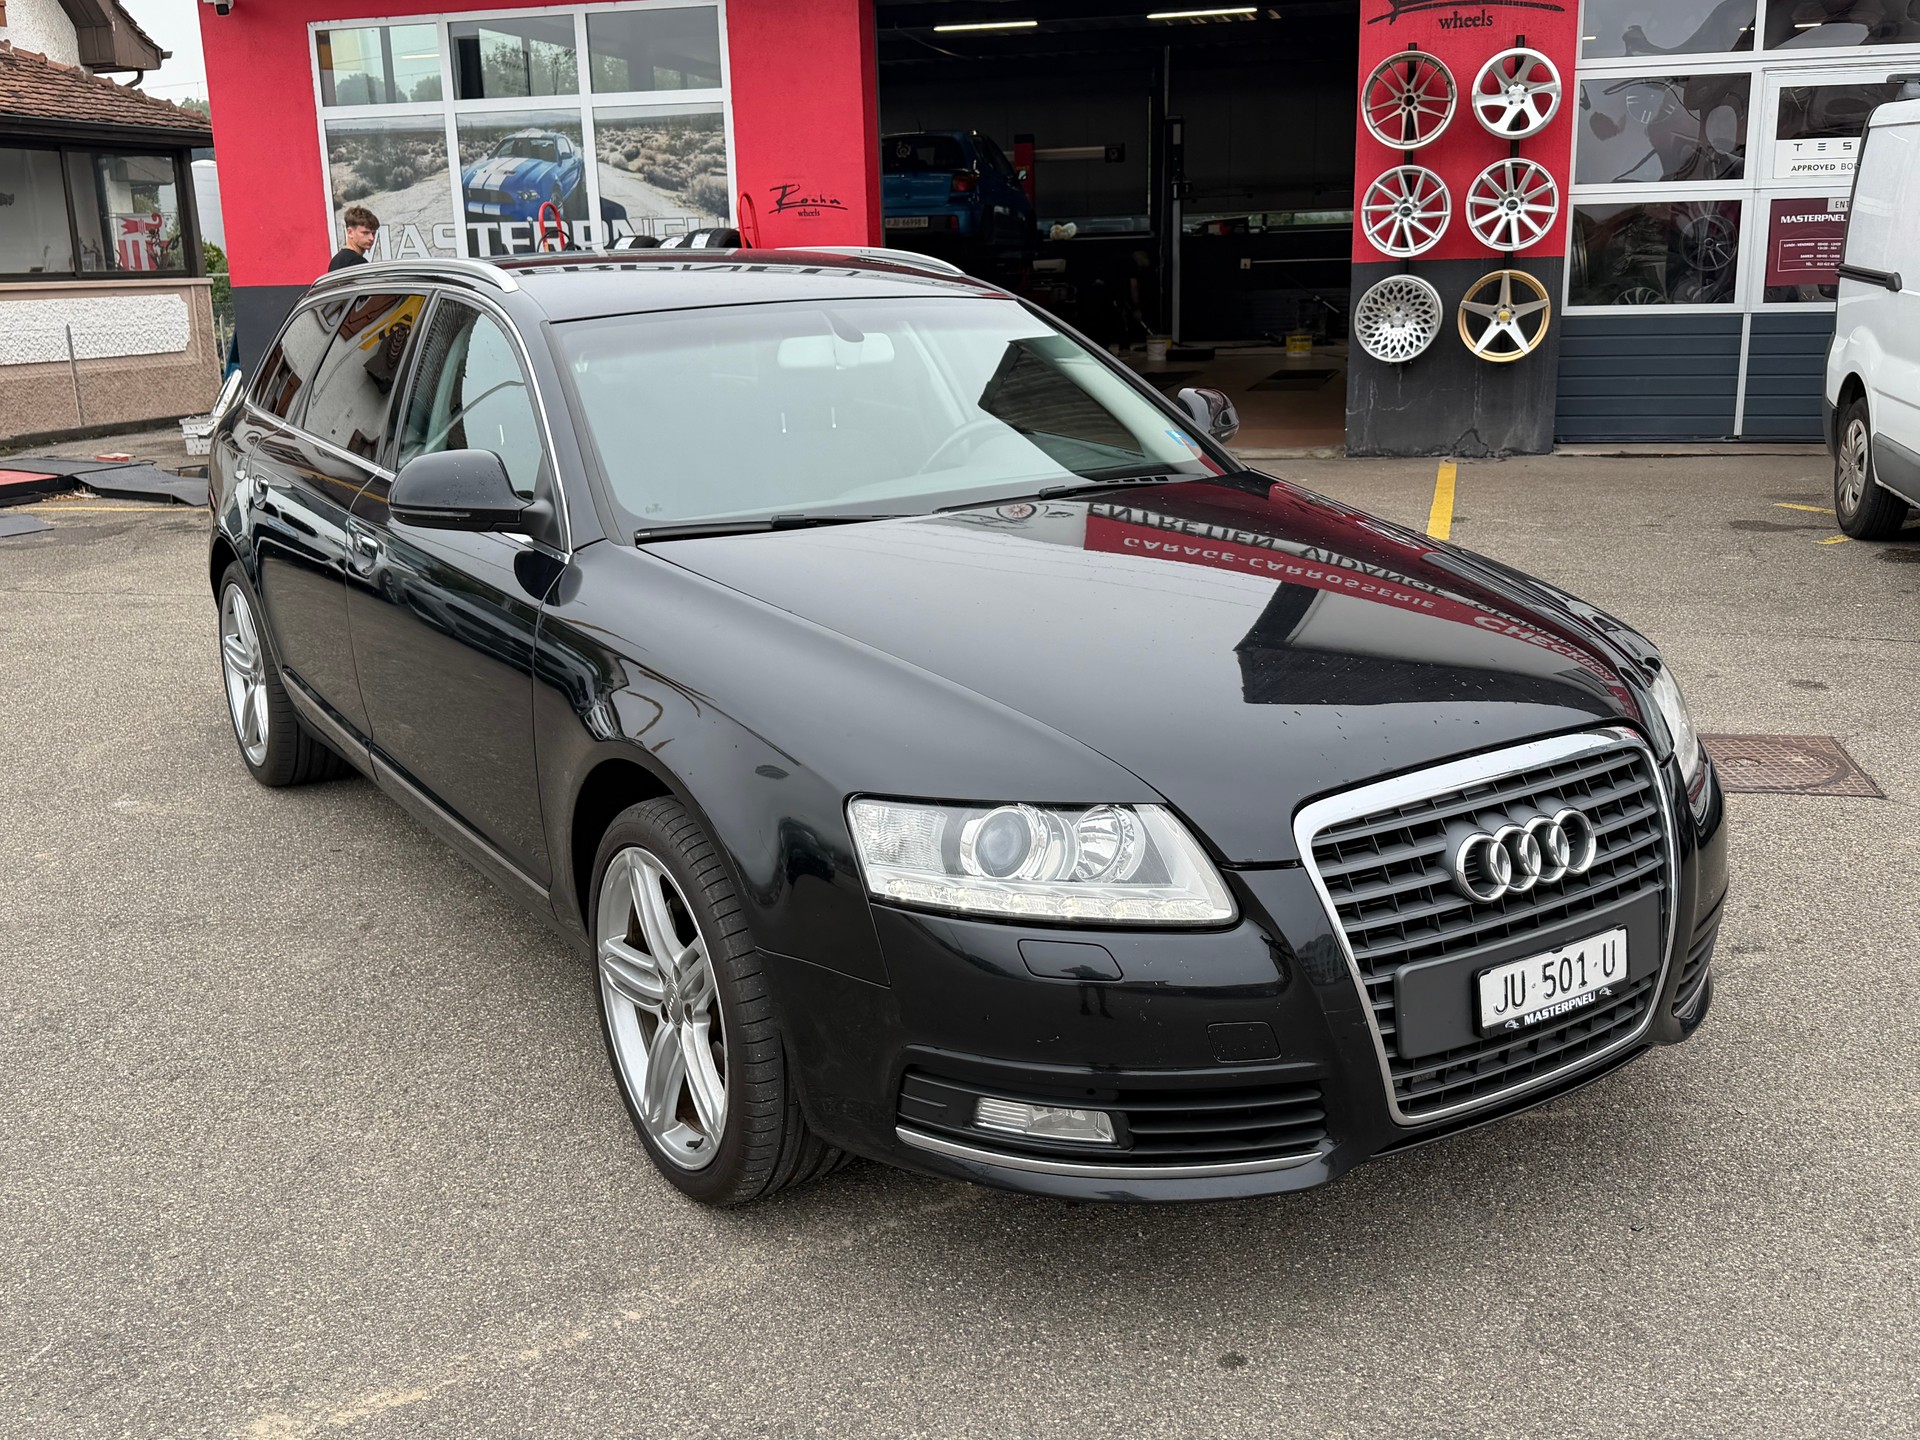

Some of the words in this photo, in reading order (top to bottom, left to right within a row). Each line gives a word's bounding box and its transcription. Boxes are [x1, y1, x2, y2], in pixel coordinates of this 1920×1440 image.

[1438, 9, 1494, 29] wheels
[1791, 163, 1836, 171] APPROVED
[1493, 969, 1526, 1015] JU
[1541, 950, 1589, 1000] 501
[1602, 938, 1616, 978] U
[1524, 991, 1596, 1026] MASTERPNEU
